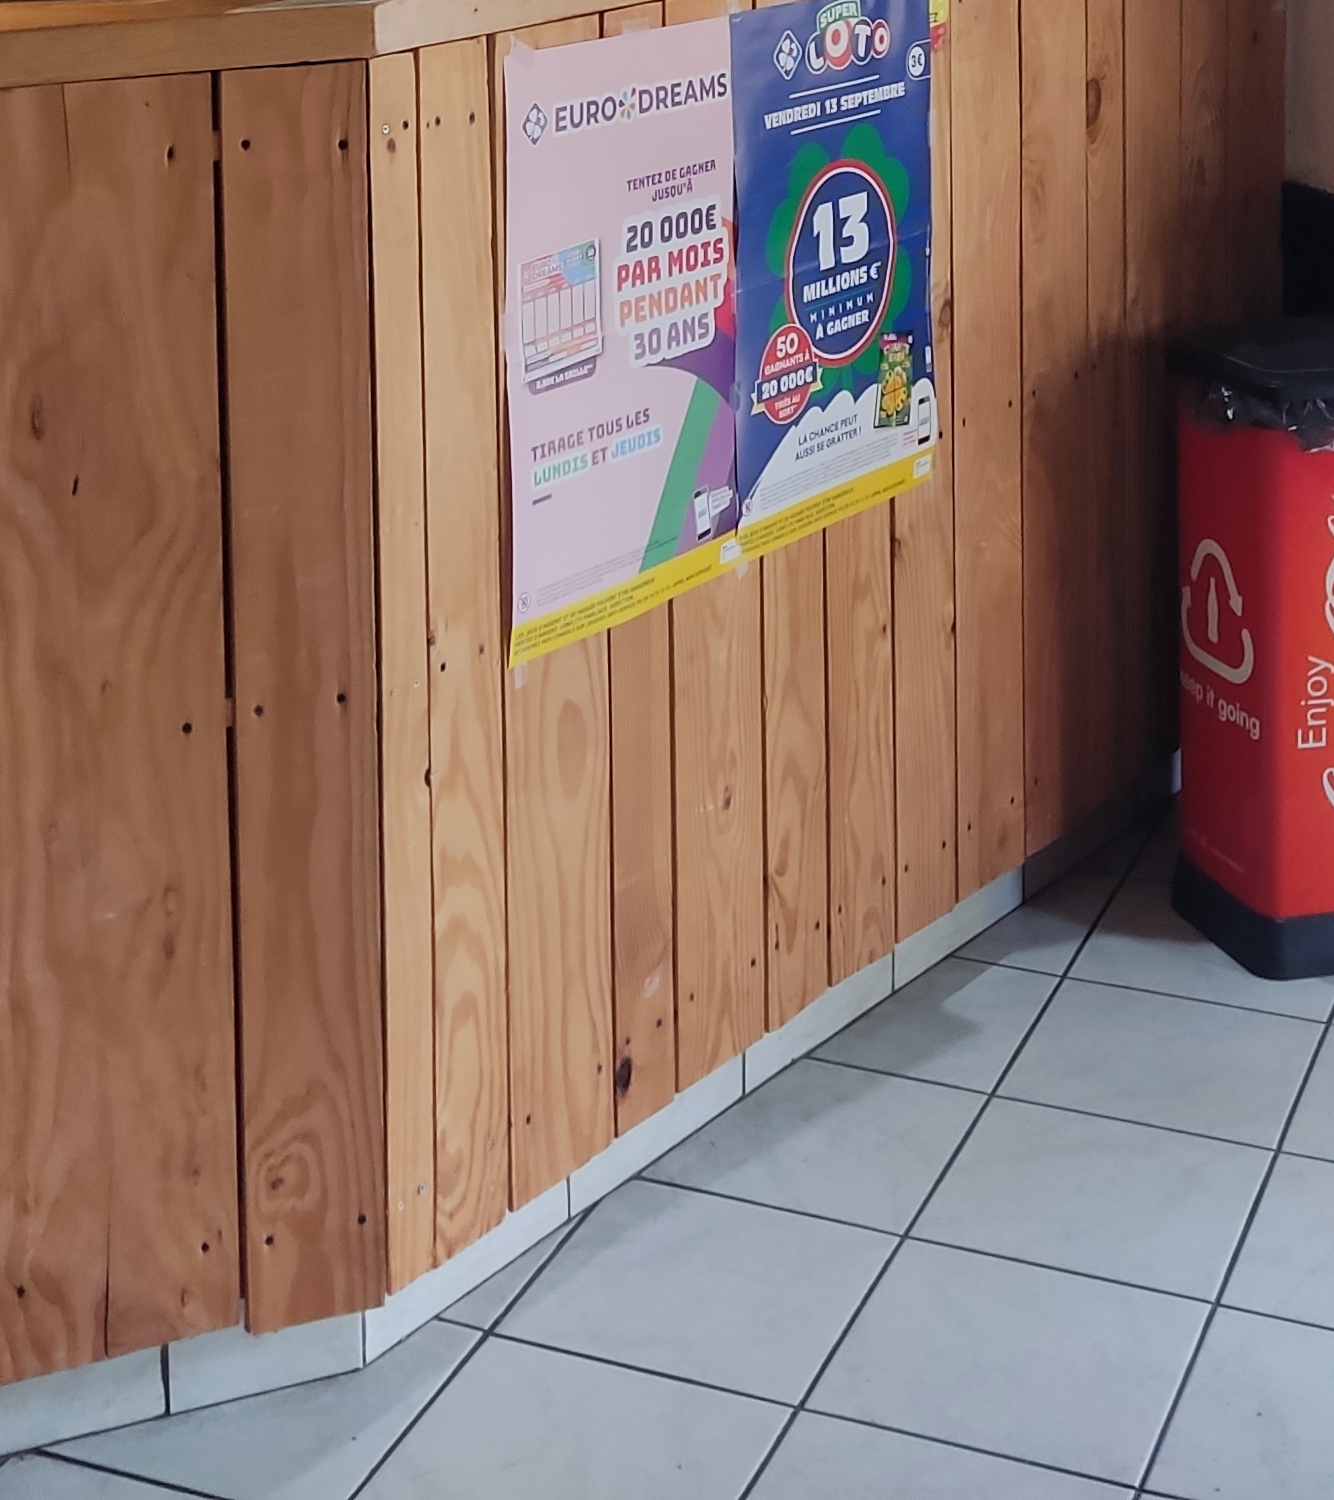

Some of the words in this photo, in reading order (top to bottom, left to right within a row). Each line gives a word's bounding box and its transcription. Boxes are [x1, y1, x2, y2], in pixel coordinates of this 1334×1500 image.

[820, 2, 858, 29] SUPER
[807, 18, 889, 72] LOTO
[910, 53, 923, 69] 3€
[764, 102, 821, 130] VENDREDI
[824, 99, 837, 115] 13
[840, 82, 905, 110] SEPTEMBRE
[627, 171, 663, 193] TENTEZ
[665, 169, 677, 182] DE
[679, 159, 716, 179] GAGNER
[652, 178, 693, 202] JUSQU'À
[626, 221, 653, 254] 20
[660, 204, 717, 244] 000€
[813, 191, 870, 271] 13
[617, 255, 662, 293] PAR
[668, 237, 724, 278] MOIS
[619, 273, 722, 328] PENDANT
[803, 267, 868, 304] MILLIONS
[810, 292, 875, 324] MINIMUM
[815, 323, 826, 341] À
[826, 309, 870, 336] GAGNER
[634, 327, 662, 361] 30
[667, 312, 710, 351] ANS
[776, 332, 799, 358] 50
[761, 381, 779, 400] 20
[780, 365, 814, 393] 000€
[764, 354, 804, 375] GAGNANTS
[531, 430, 585, 462] TIRAGE
[587, 417, 622, 443] TOUS
[626, 407, 650, 429] LES
[794, 442, 816, 462] AUSSI
[816, 442, 826, 454] SE
[826, 429, 858, 451] GRATTER
[798, 434, 809, 446] LA
[809, 421, 839, 442] CHANCE
[840, 414, 858, 432] PEUT
[533, 454, 588, 487] LUNDIS
[592, 447, 608, 466] ET
[611, 428, 661, 459] JEUDIS
[1206, 684, 1215, 703] it
[1218, 699, 1260, 740] going
